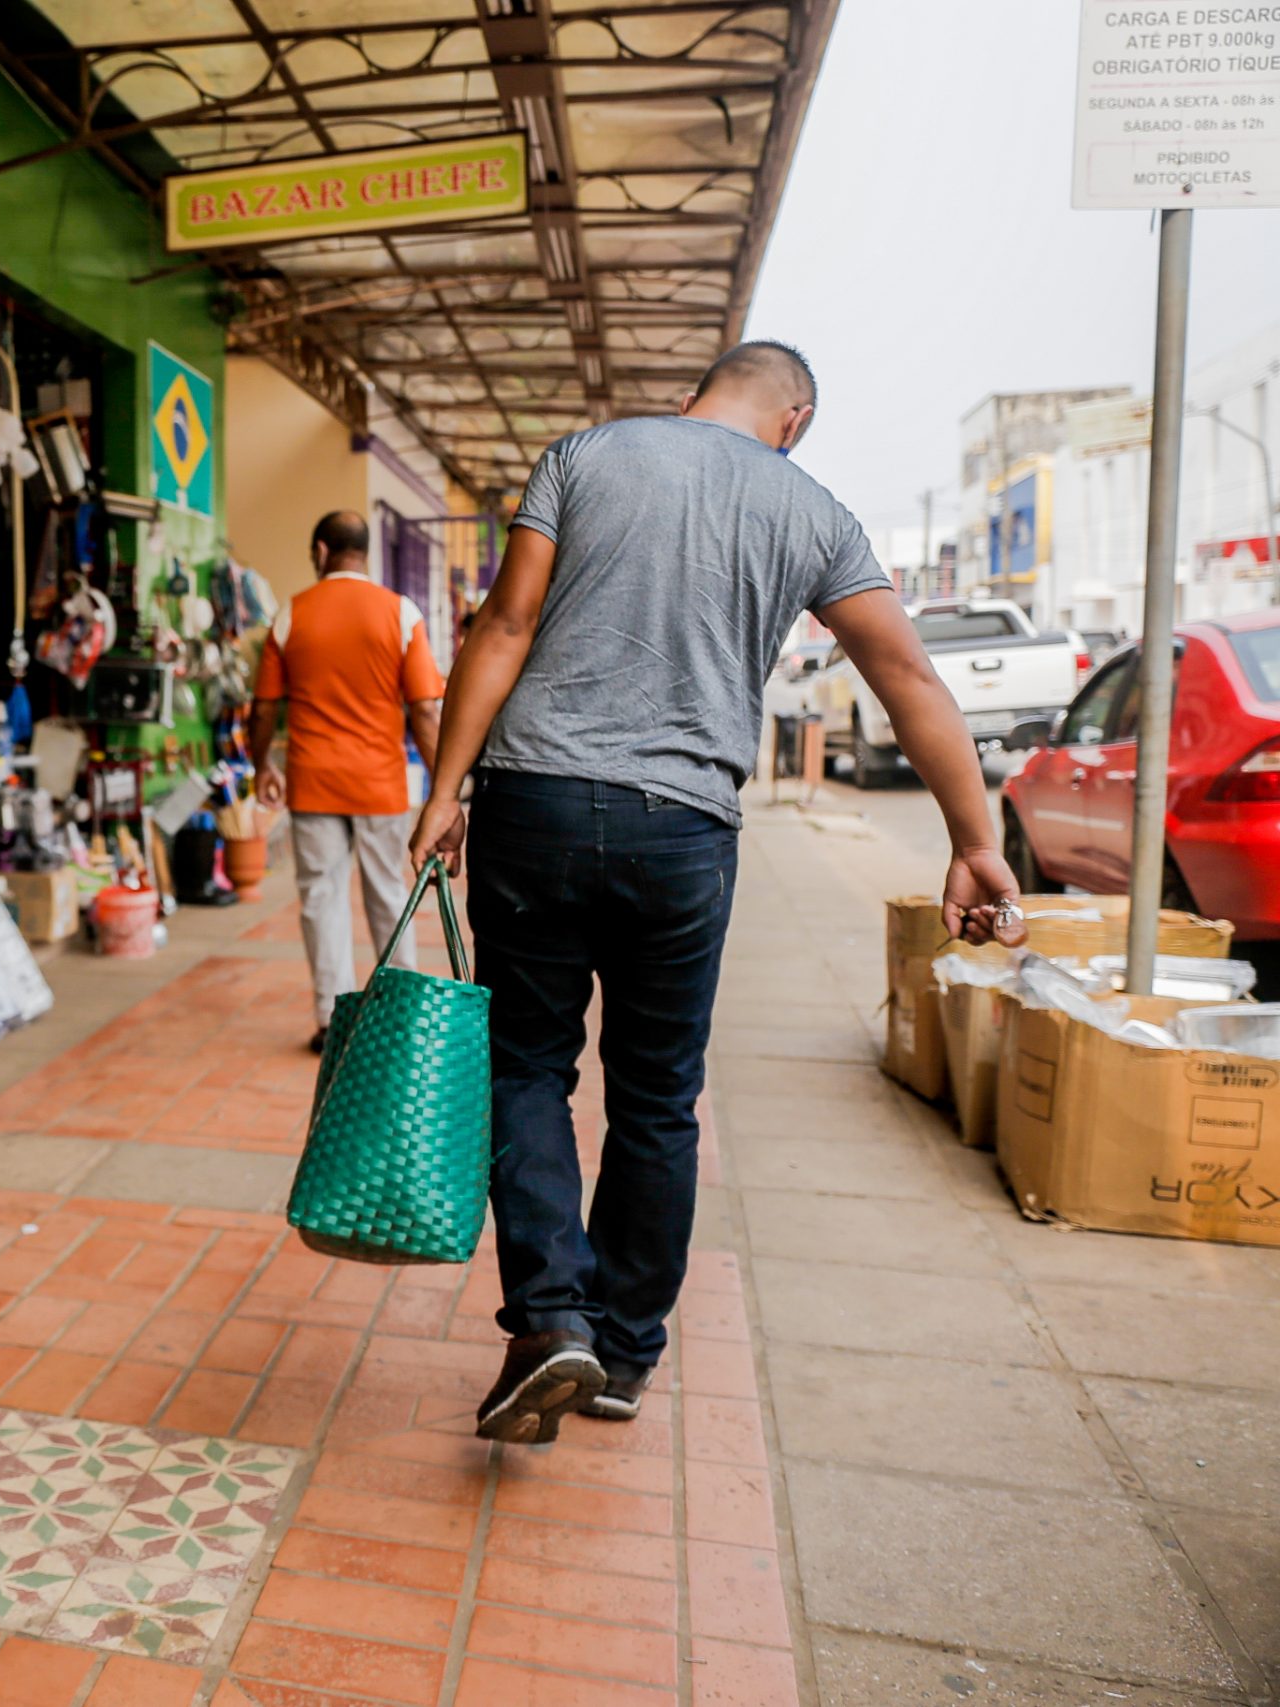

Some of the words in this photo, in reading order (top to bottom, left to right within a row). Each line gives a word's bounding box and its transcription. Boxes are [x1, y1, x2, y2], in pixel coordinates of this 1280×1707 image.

[1105, 11, 1170, 27] CARGA
[1176, 10, 1187, 25] E
[1126, 31, 1161, 49] ATÉ
[1167, 33, 1203, 48] PBT
[1208, 31, 1274, 49] 9.000kg
[1092, 56, 1221, 75] OBRIGATÓRIO
[1227, 53, 1280, 72] TÍQUE
[1088, 97, 1156, 110] SEGUNDA
[1160, 97, 1170, 108] A
[1174, 95, 1219, 108] SEXTA
[1123, 118, 1182, 132] SÁBADO
[1242, 117, 1265, 130] 12h
[1157, 151, 1230, 165] PROIBIDO
[1133, 171, 1252, 185] MOTOCICLETAS
[189, 178, 345, 225] BAZAR
[359, 159, 506, 205] CHEFE
